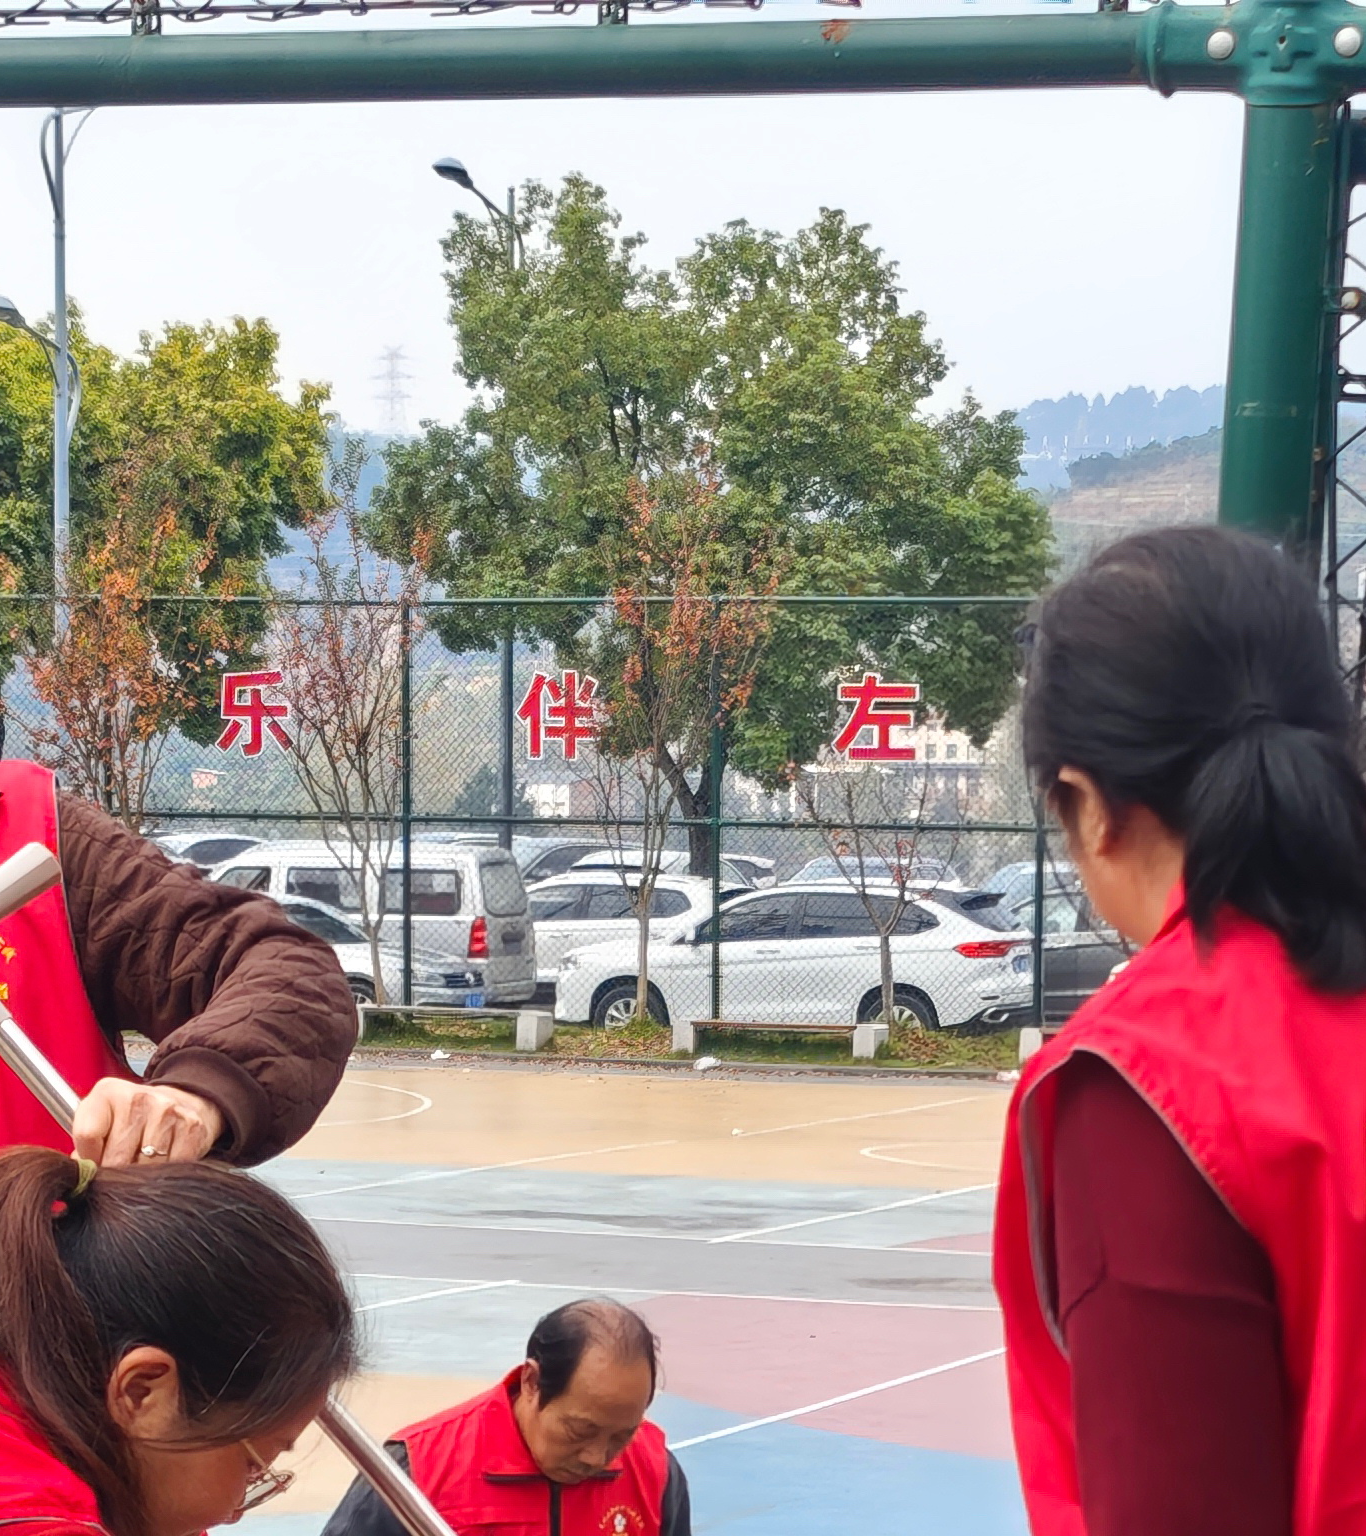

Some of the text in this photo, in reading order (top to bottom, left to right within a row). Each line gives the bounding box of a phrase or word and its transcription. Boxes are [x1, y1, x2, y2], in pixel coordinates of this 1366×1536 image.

[216, 669, 292, 758] 乐
[516, 670, 599, 760] 伴
[834, 672, 919, 761] 左
